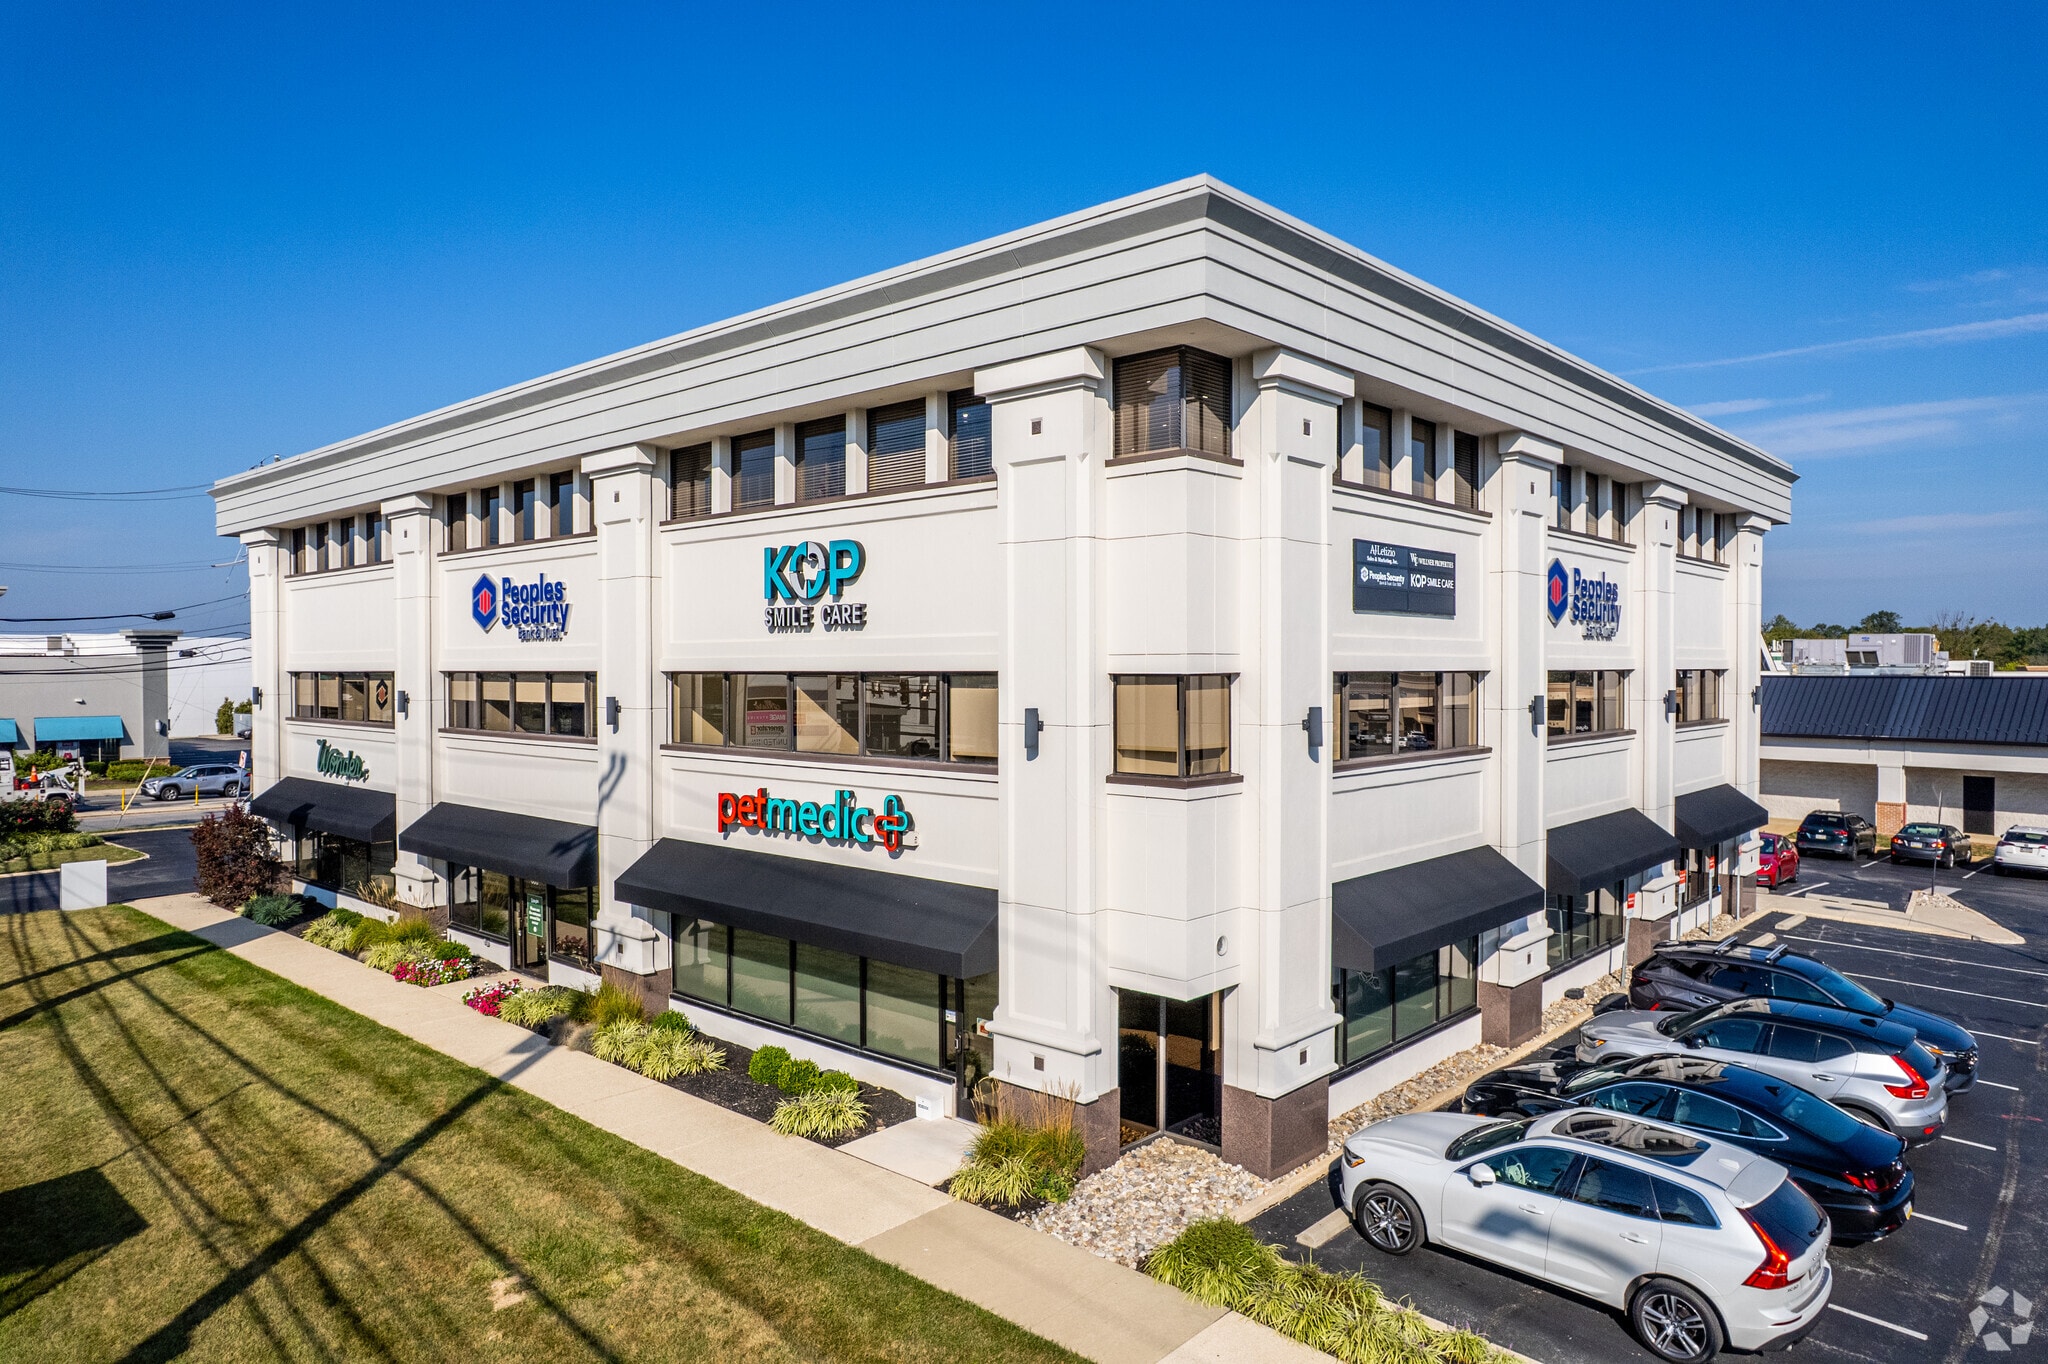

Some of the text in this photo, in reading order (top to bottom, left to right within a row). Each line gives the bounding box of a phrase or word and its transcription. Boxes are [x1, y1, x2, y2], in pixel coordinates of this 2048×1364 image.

[764, 539, 861, 599] KOP
[1369, 570, 1387, 582] Peoples
[1386, 572, 1405, 585] Security
[1410, 573, 1427, 588] KOP
[1427, 577, 1441, 588] SMILE
[1441, 579, 1454, 589] CARE
[501, 572, 564, 606] Peoples
[1573, 567, 1618, 606] Peoples
[501, 600, 569, 632] Security
[764, 603, 862, 628] SMILE CARE
[1572, 593, 1622, 633] Security
[718, 788, 868, 843] petmedic
